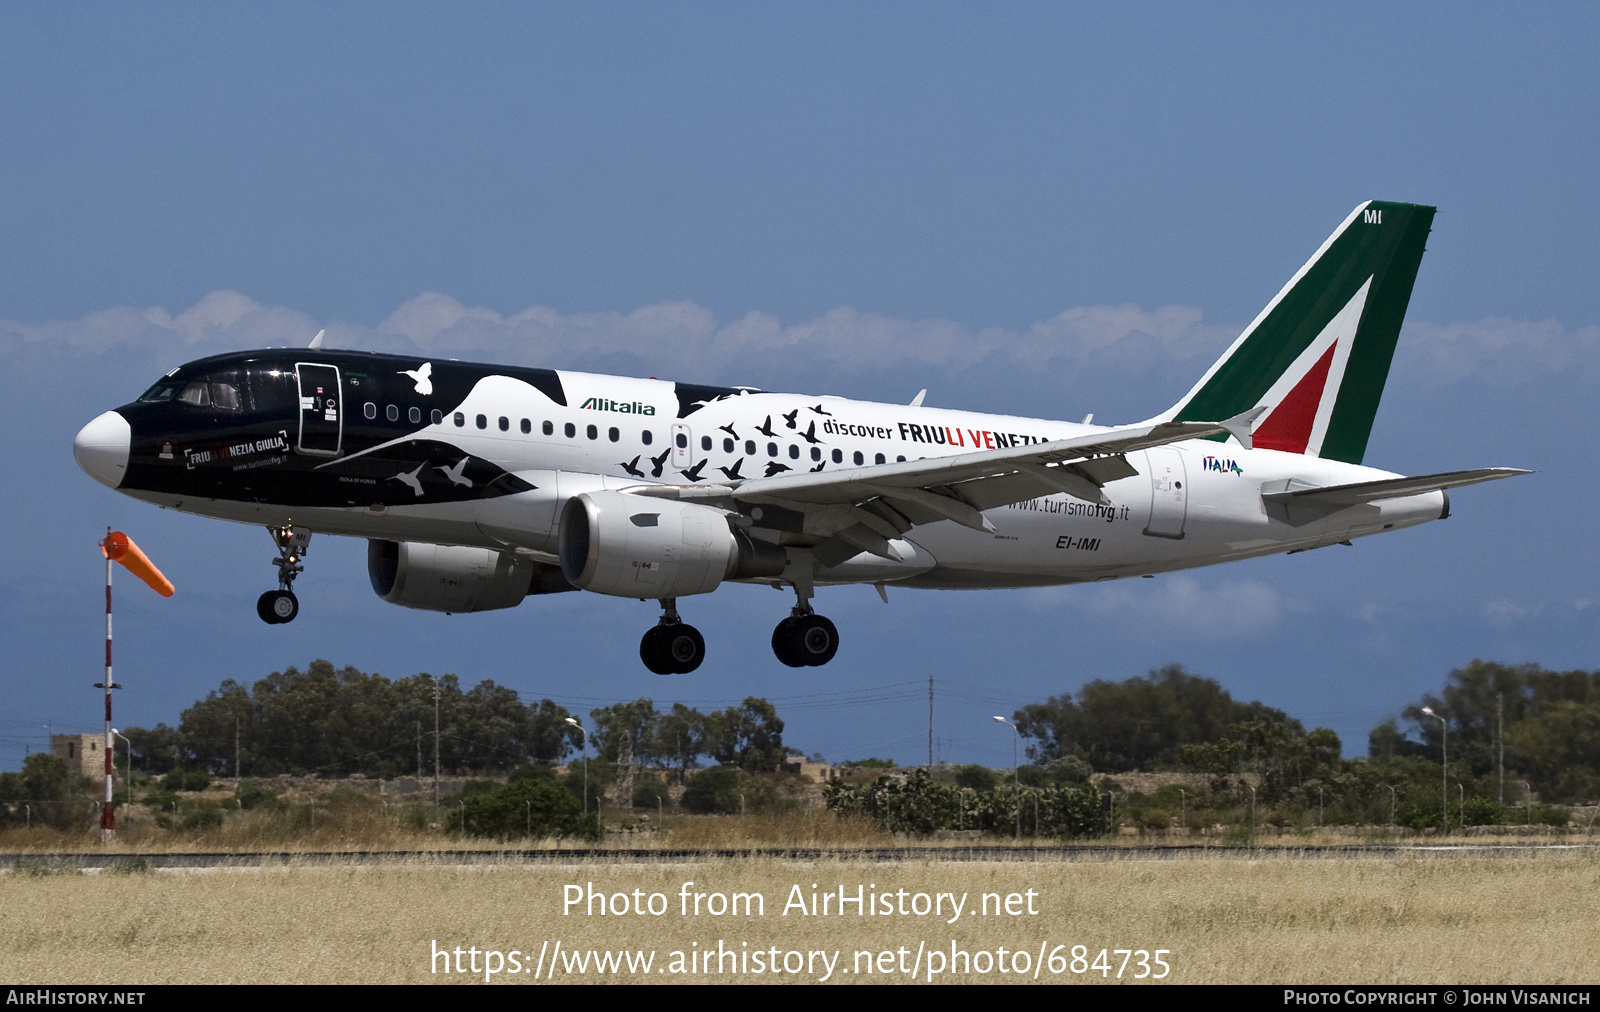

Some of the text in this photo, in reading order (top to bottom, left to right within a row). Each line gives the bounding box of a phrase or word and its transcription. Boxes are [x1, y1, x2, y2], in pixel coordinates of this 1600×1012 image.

[1364, 209, 1382, 224] MI
[580, 397, 656, 416] Alitalia
[823, 419, 1050, 450] discover FRIULI VENEZI
[256, 436, 285, 452] GIULIA
[233, 455, 288, 471] www.turismofvg.it
[1202, 454, 1244, 477] ITALIA
[295, 533, 306, 541] MI
[1055, 535, 1101, 551] EI-IMI
